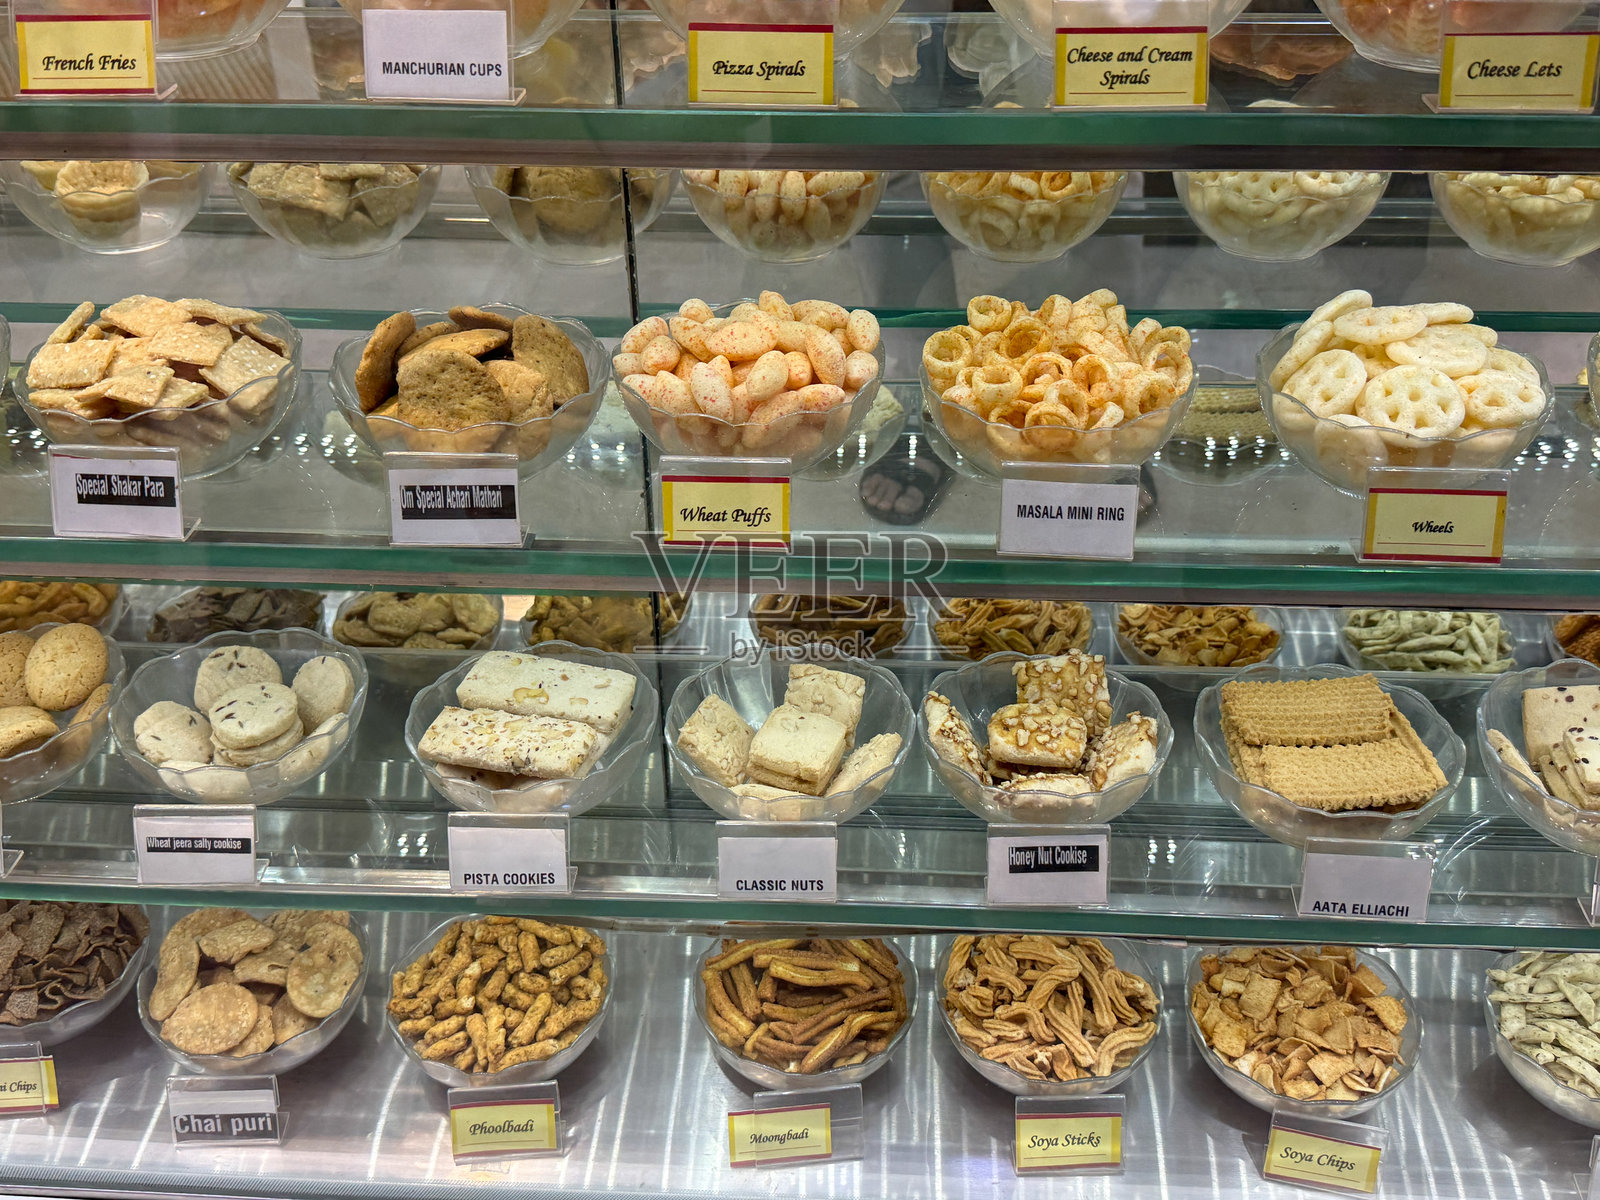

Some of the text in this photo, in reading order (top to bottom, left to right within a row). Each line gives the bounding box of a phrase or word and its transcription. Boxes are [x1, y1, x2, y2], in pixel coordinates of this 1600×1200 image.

[42, 53, 137, 71] French Fries
[1067, 46, 1193, 64] Cheese and Cream
[382, 62, 502, 77] MANCHURIAN CUPS
[712, 58, 805, 80] Pizza Spirals
[1467, 59, 1562, 79] Cheese Lets
[1099, 69, 1151, 88] Spirals
[76, 474, 166, 498] Special Shakar Para
[400, 487, 413, 509] Om
[416, 486, 444, 510] Special
[446, 486, 470, 509] Achari
[679, 505, 772, 526] Wheat Puffs
[1016, 503, 1125, 521] MASALA MINI RING
[1412, 520, 1454, 536] Wheels
[146, 836, 242, 852] Wheat jeera salty cookise
[1009, 847, 1088, 866] Honey Nut Cookise
[463, 872, 556, 886] PISTA COOKIES
[736, 879, 824, 893] CLASSIC NUTS
[1312, 901, 1409, 918] AATA ELLIACHI
[9, 1078, 37, 1095] Chips
[174, 1112, 273, 1138] Chai puri
[469, 1118, 535, 1138] Phoolbadi
[749, 1129, 809, 1146] Moongbadi
[1028, 1131, 1102, 1152] Soya Sticks
[1279, 1146, 1356, 1174] Soya Chips
